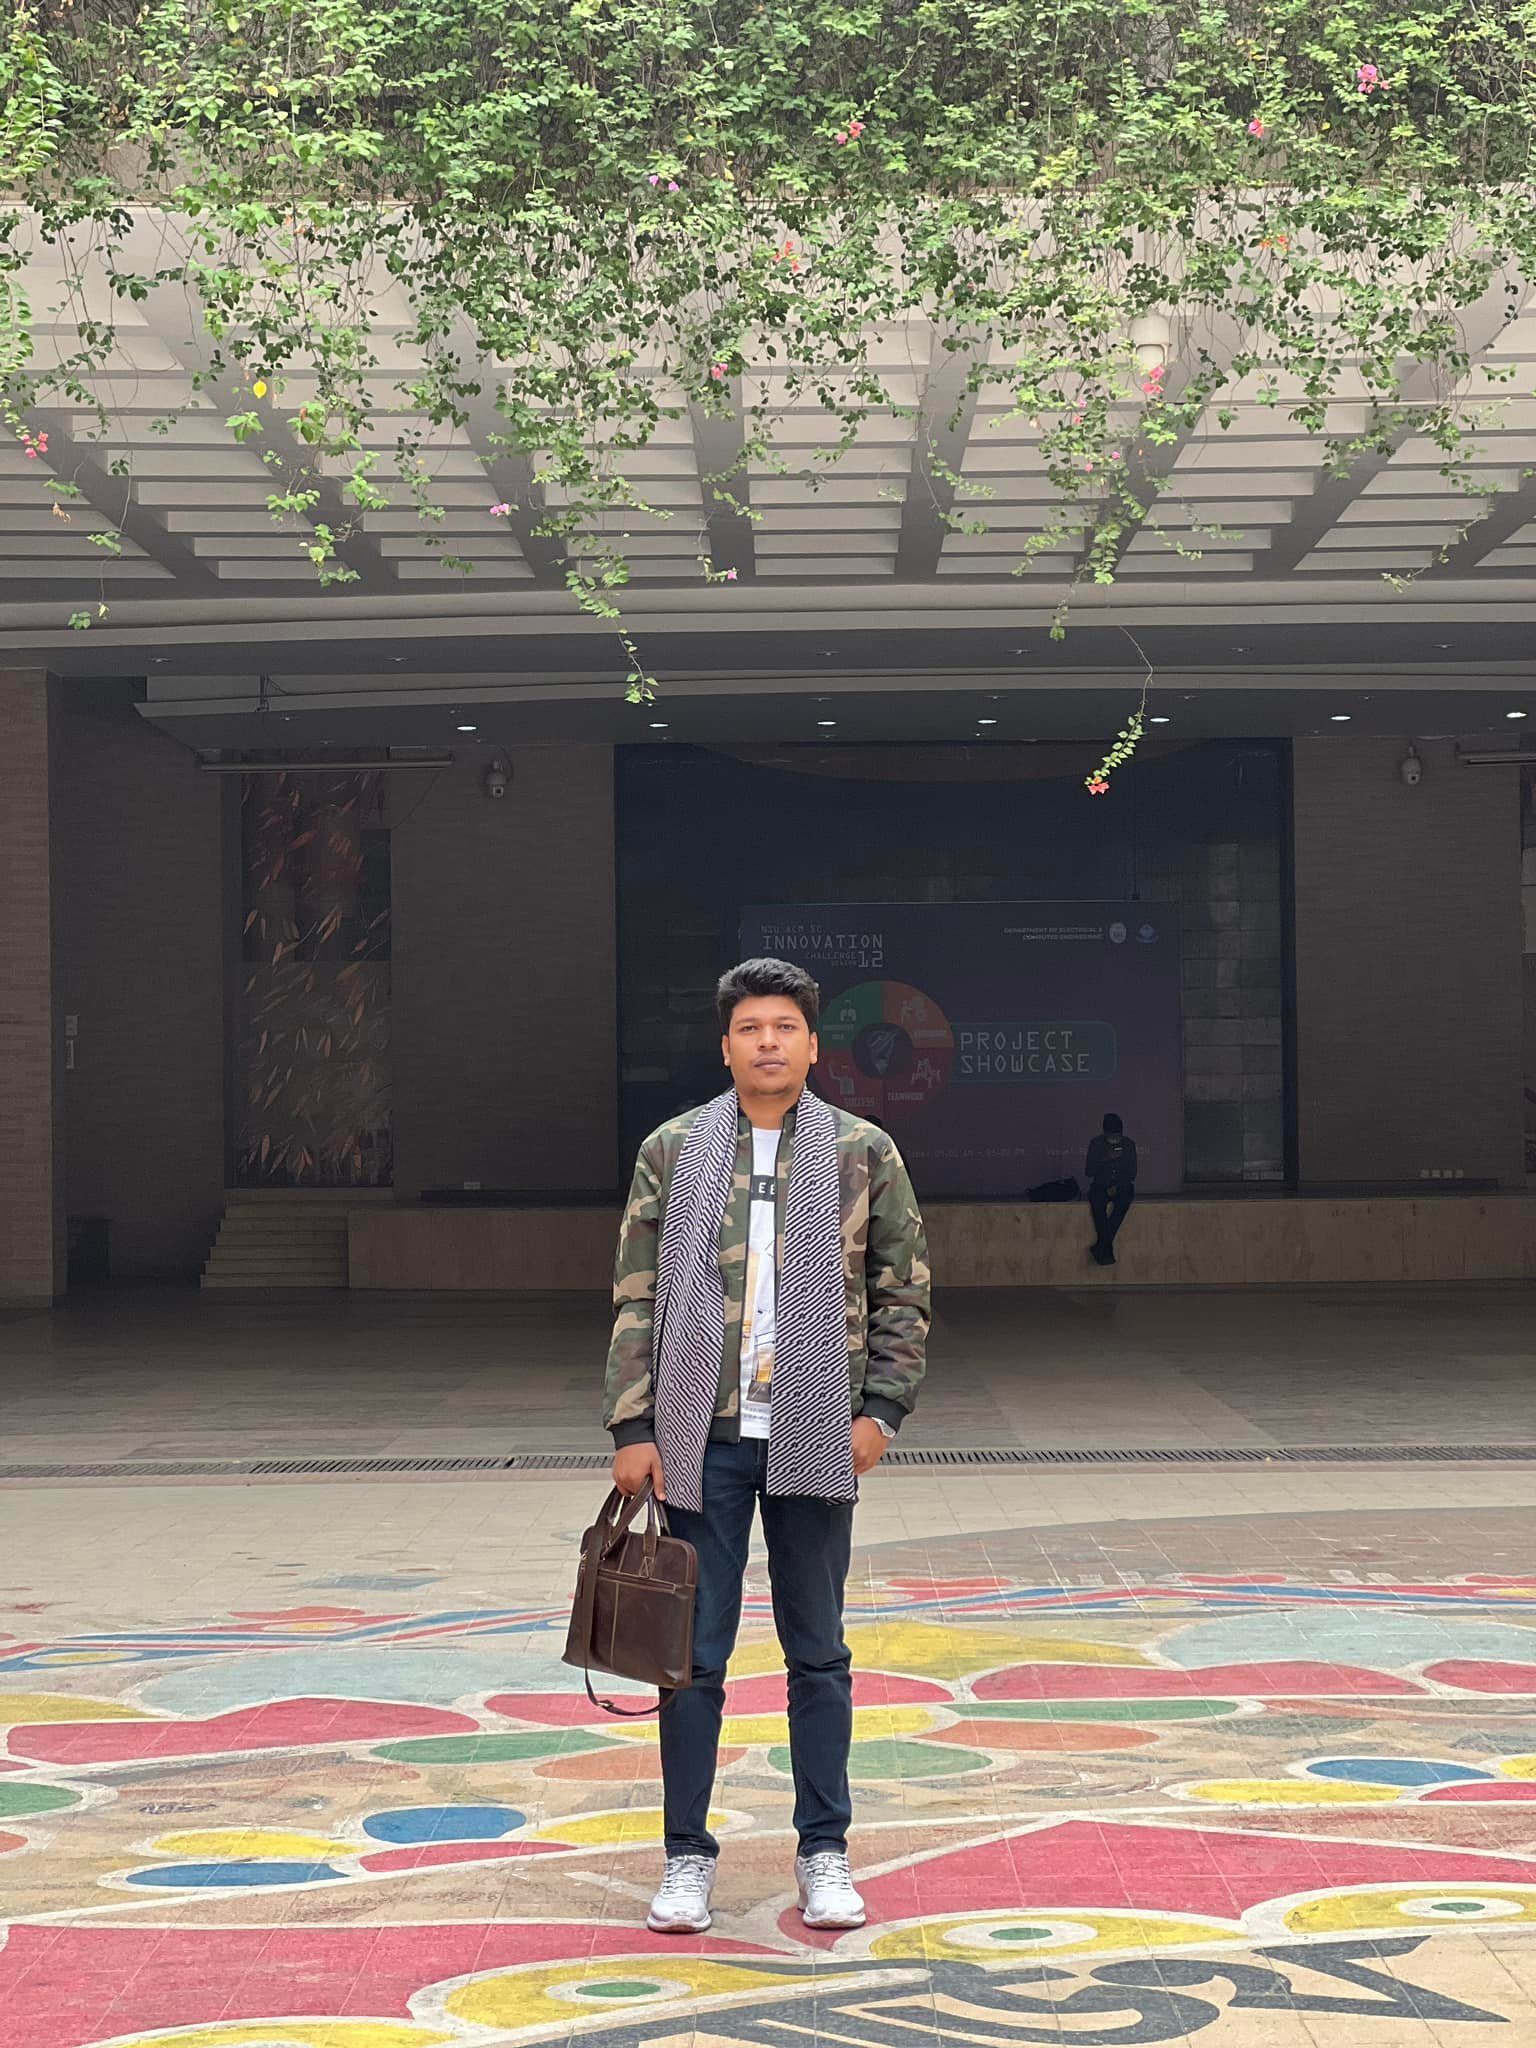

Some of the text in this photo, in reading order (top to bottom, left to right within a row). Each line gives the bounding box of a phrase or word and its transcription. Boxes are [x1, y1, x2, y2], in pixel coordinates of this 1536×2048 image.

[763, 934, 883, 950] INNOVATION
[806, 950, 884, 968] CHALLENGE 12
[960, 1031, 1073, 1051] PROJECT
[960, 1053, 1090, 1074] SHOWCASE
